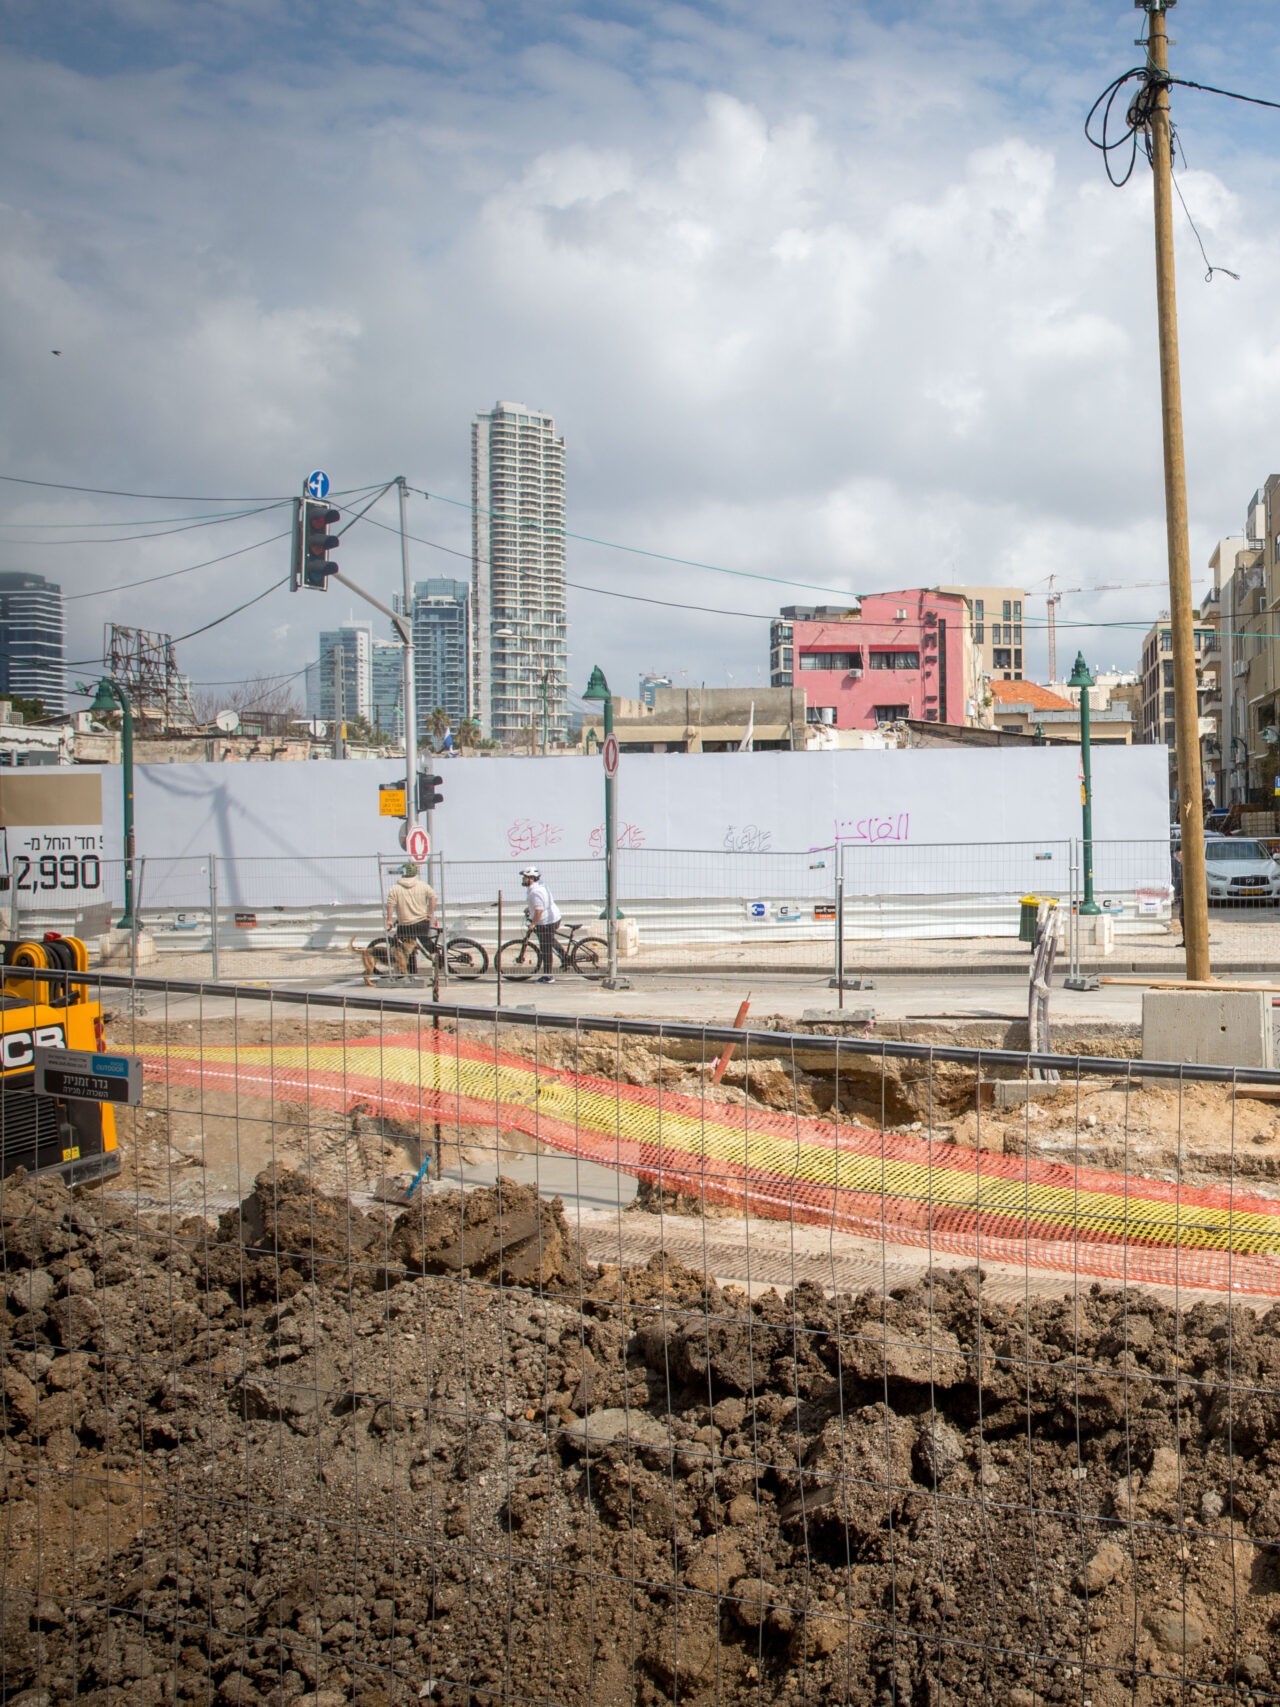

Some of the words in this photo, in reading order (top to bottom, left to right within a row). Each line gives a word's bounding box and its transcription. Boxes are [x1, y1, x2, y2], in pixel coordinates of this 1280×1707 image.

[44, 834, 71, 850] החל
[13, 854, 100, 894] 2,990
[63, 1074, 89, 1087] זמנית
[92, 1078, 108, 1090] גדר
